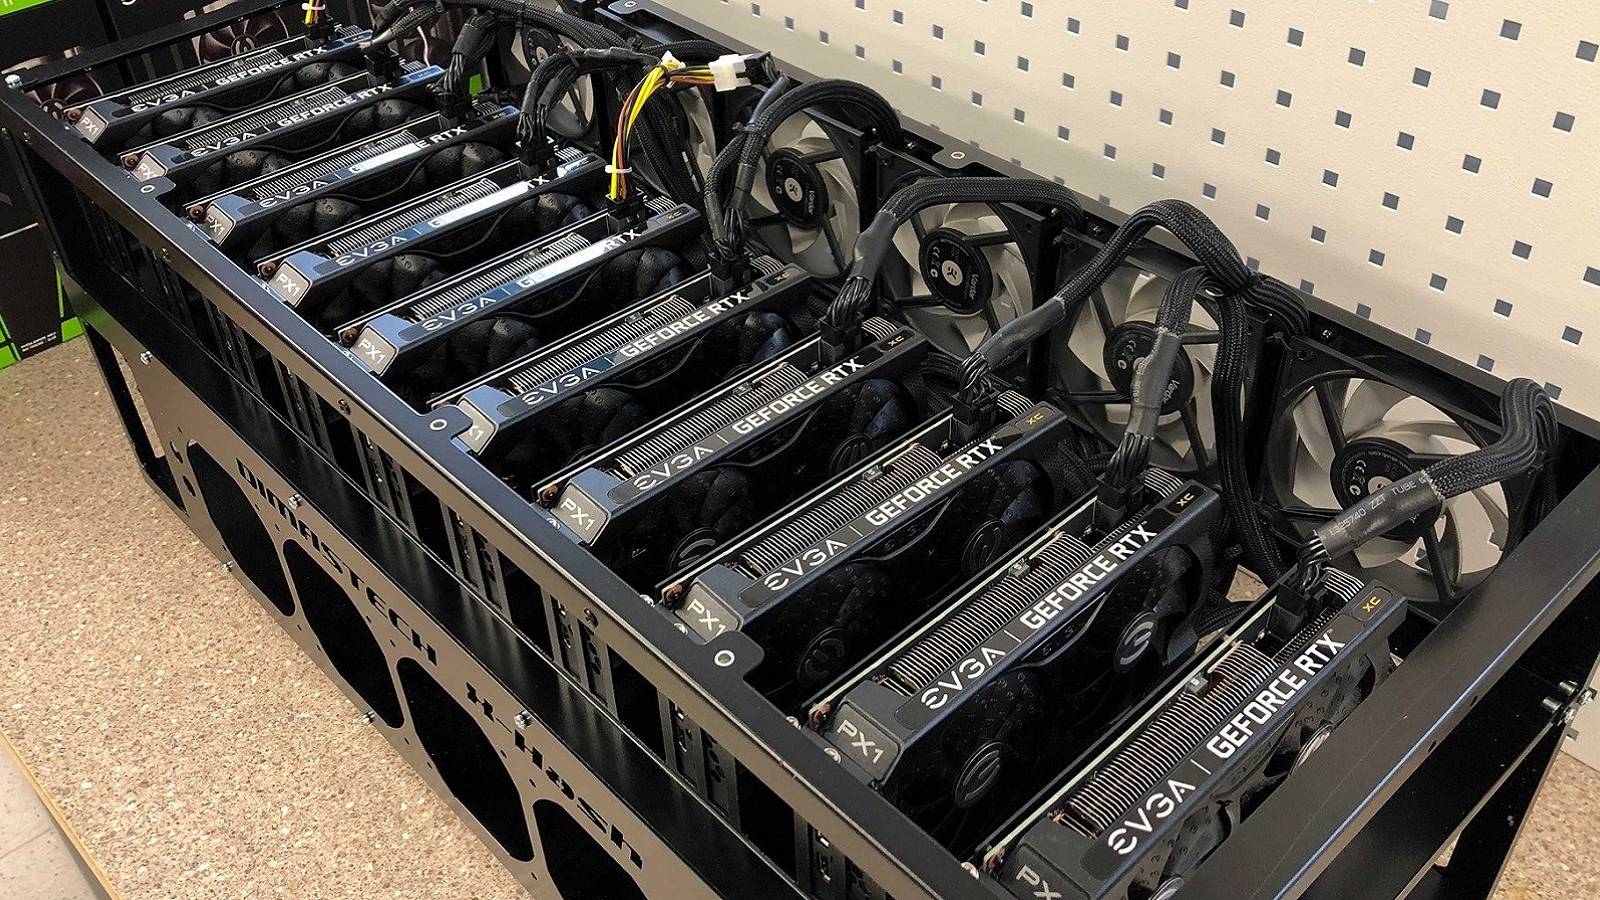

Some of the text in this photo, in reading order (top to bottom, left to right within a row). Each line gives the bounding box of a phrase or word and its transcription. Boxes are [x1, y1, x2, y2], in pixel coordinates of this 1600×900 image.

[131, 46, 328, 112] EVGA GEFORCE RTX
[80, 117, 99, 135] PX1
[190, 84, 393, 157] EVGA GEFORCE RTX
[138, 163, 158, 179] PX
[258, 125, 467, 208] EVGA RTX
[205, 213, 226, 236] PX1
[335, 235, 407, 266] EVGA
[276, 272, 300, 297] PX1
[421, 229, 641, 332] EVGA RTX
[357, 337, 386, 365] PX1
[522, 291, 749, 406] EVGA GEFORCE RTX
[887, 334, 906, 346] XC
[633, 358, 864, 490] EVGA GEFORCE RTX
[1025, 411, 1045, 426] XC
[1176, 492, 1196, 507] XC
[1391, 480, 1417, 496] TUBE
[560, 497, 595, 532] PX1
[763, 439, 1003, 591] EVGA GEFORCE RTX
[920, 524, 1157, 710] EVGA GEFORCE RTX
[1362, 595, 1382, 613] XC
[836, 719, 885, 765] PX1
[1107, 631, 1346, 855] EVGA GEFORCE RTX
